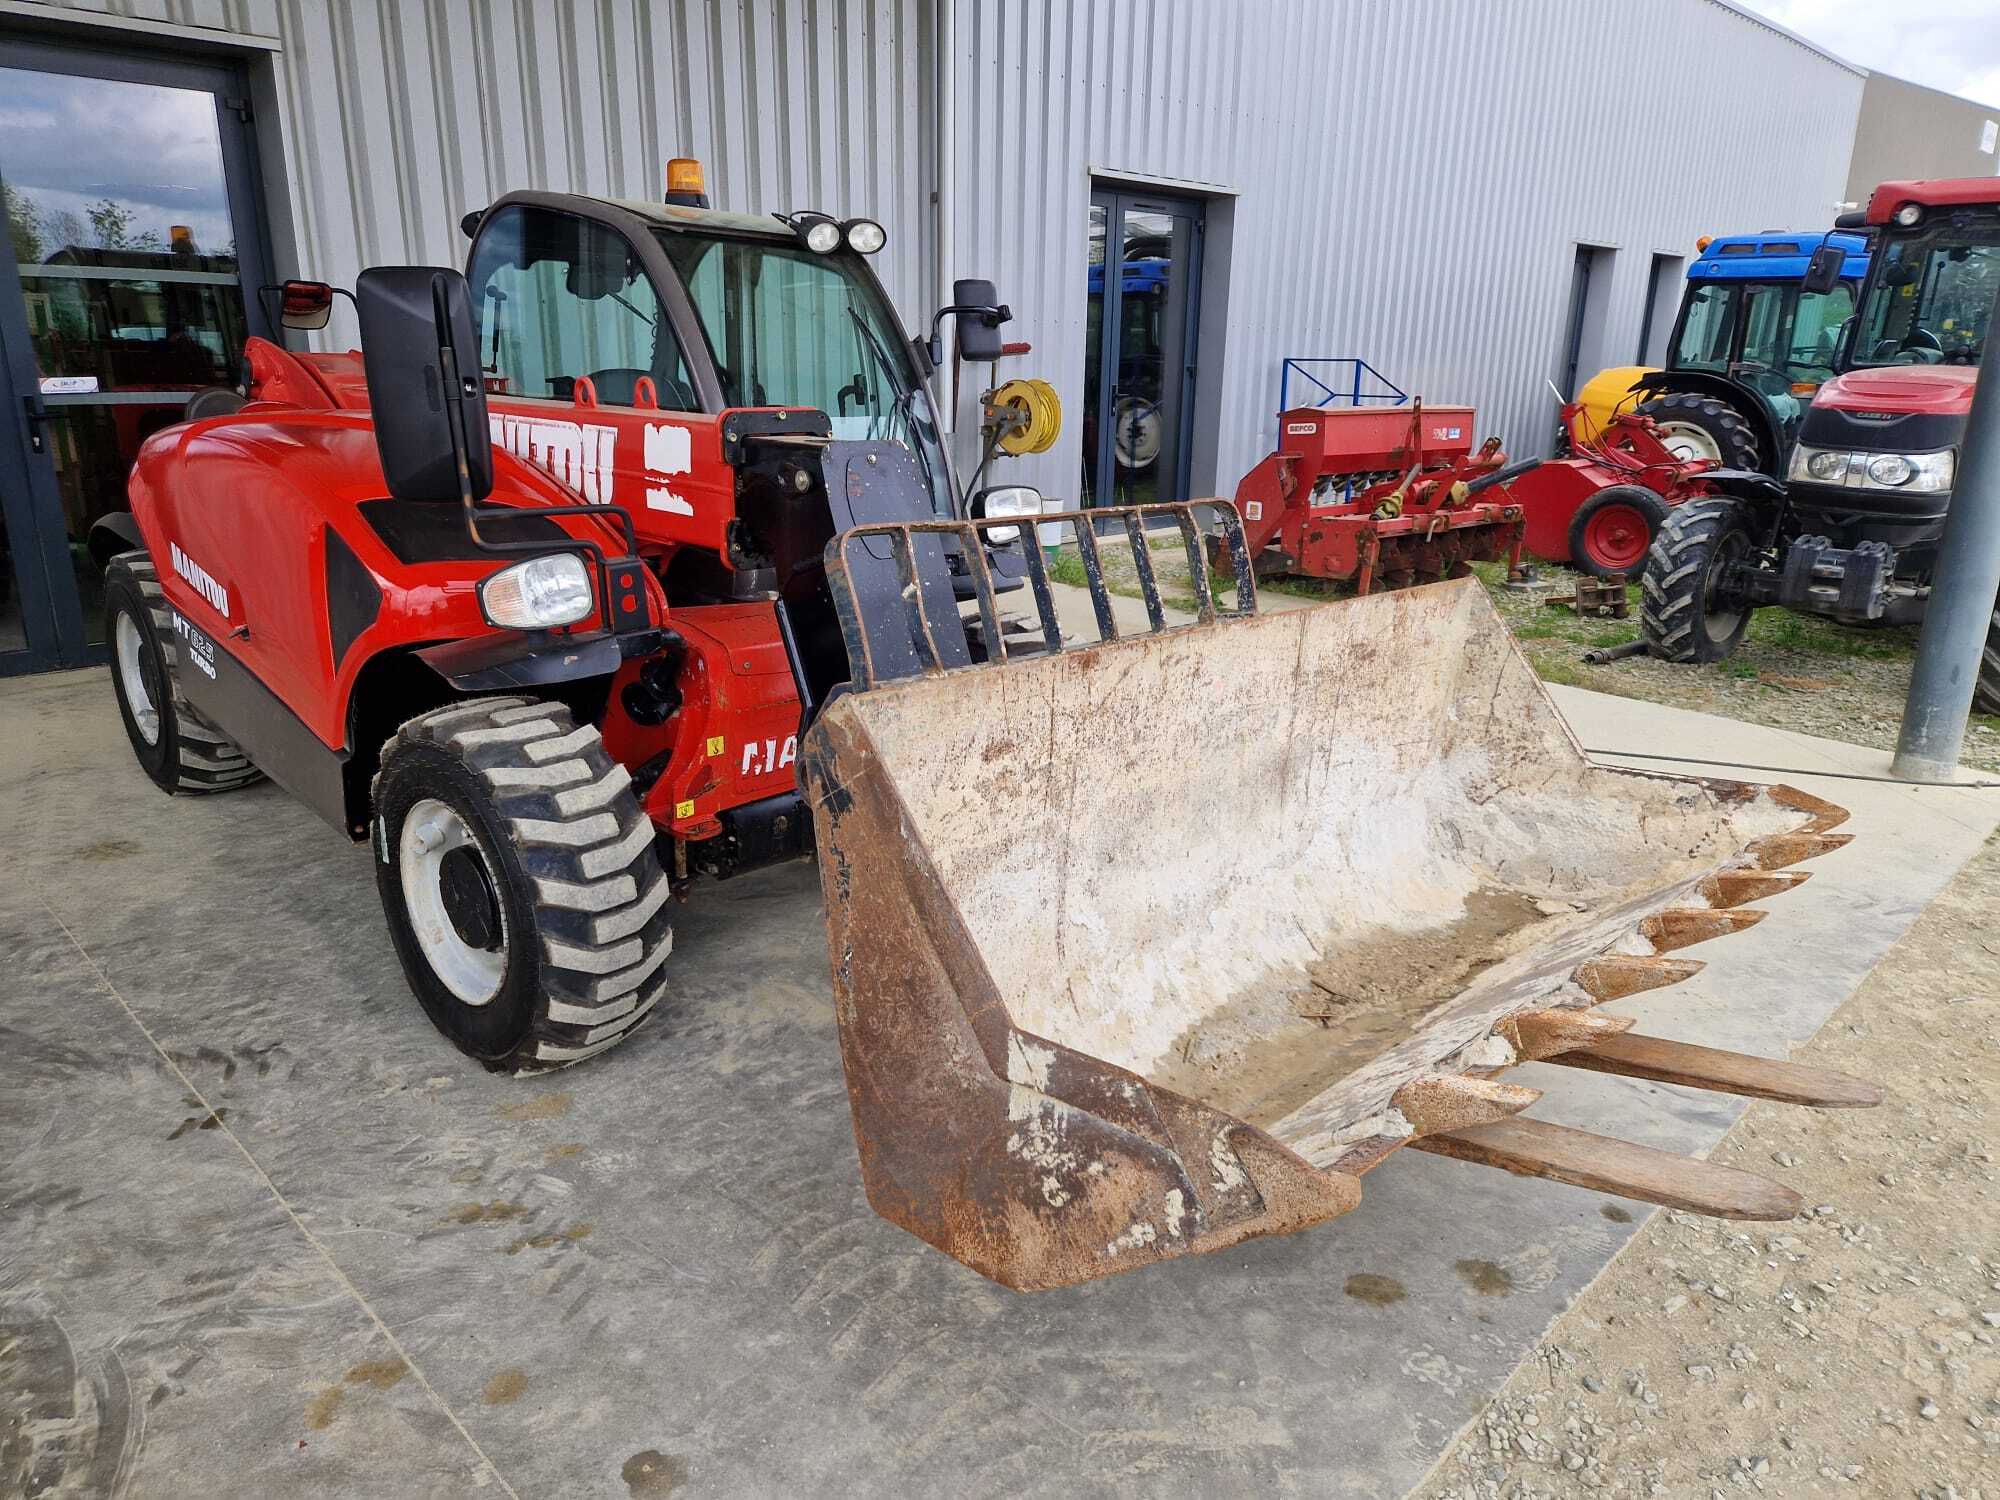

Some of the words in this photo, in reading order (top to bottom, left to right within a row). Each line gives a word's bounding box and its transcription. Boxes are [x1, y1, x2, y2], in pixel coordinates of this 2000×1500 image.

[170, 541, 229, 618] MANITOU
[172, 611, 191, 640] MT
[189, 647, 217, 680] TURBO
